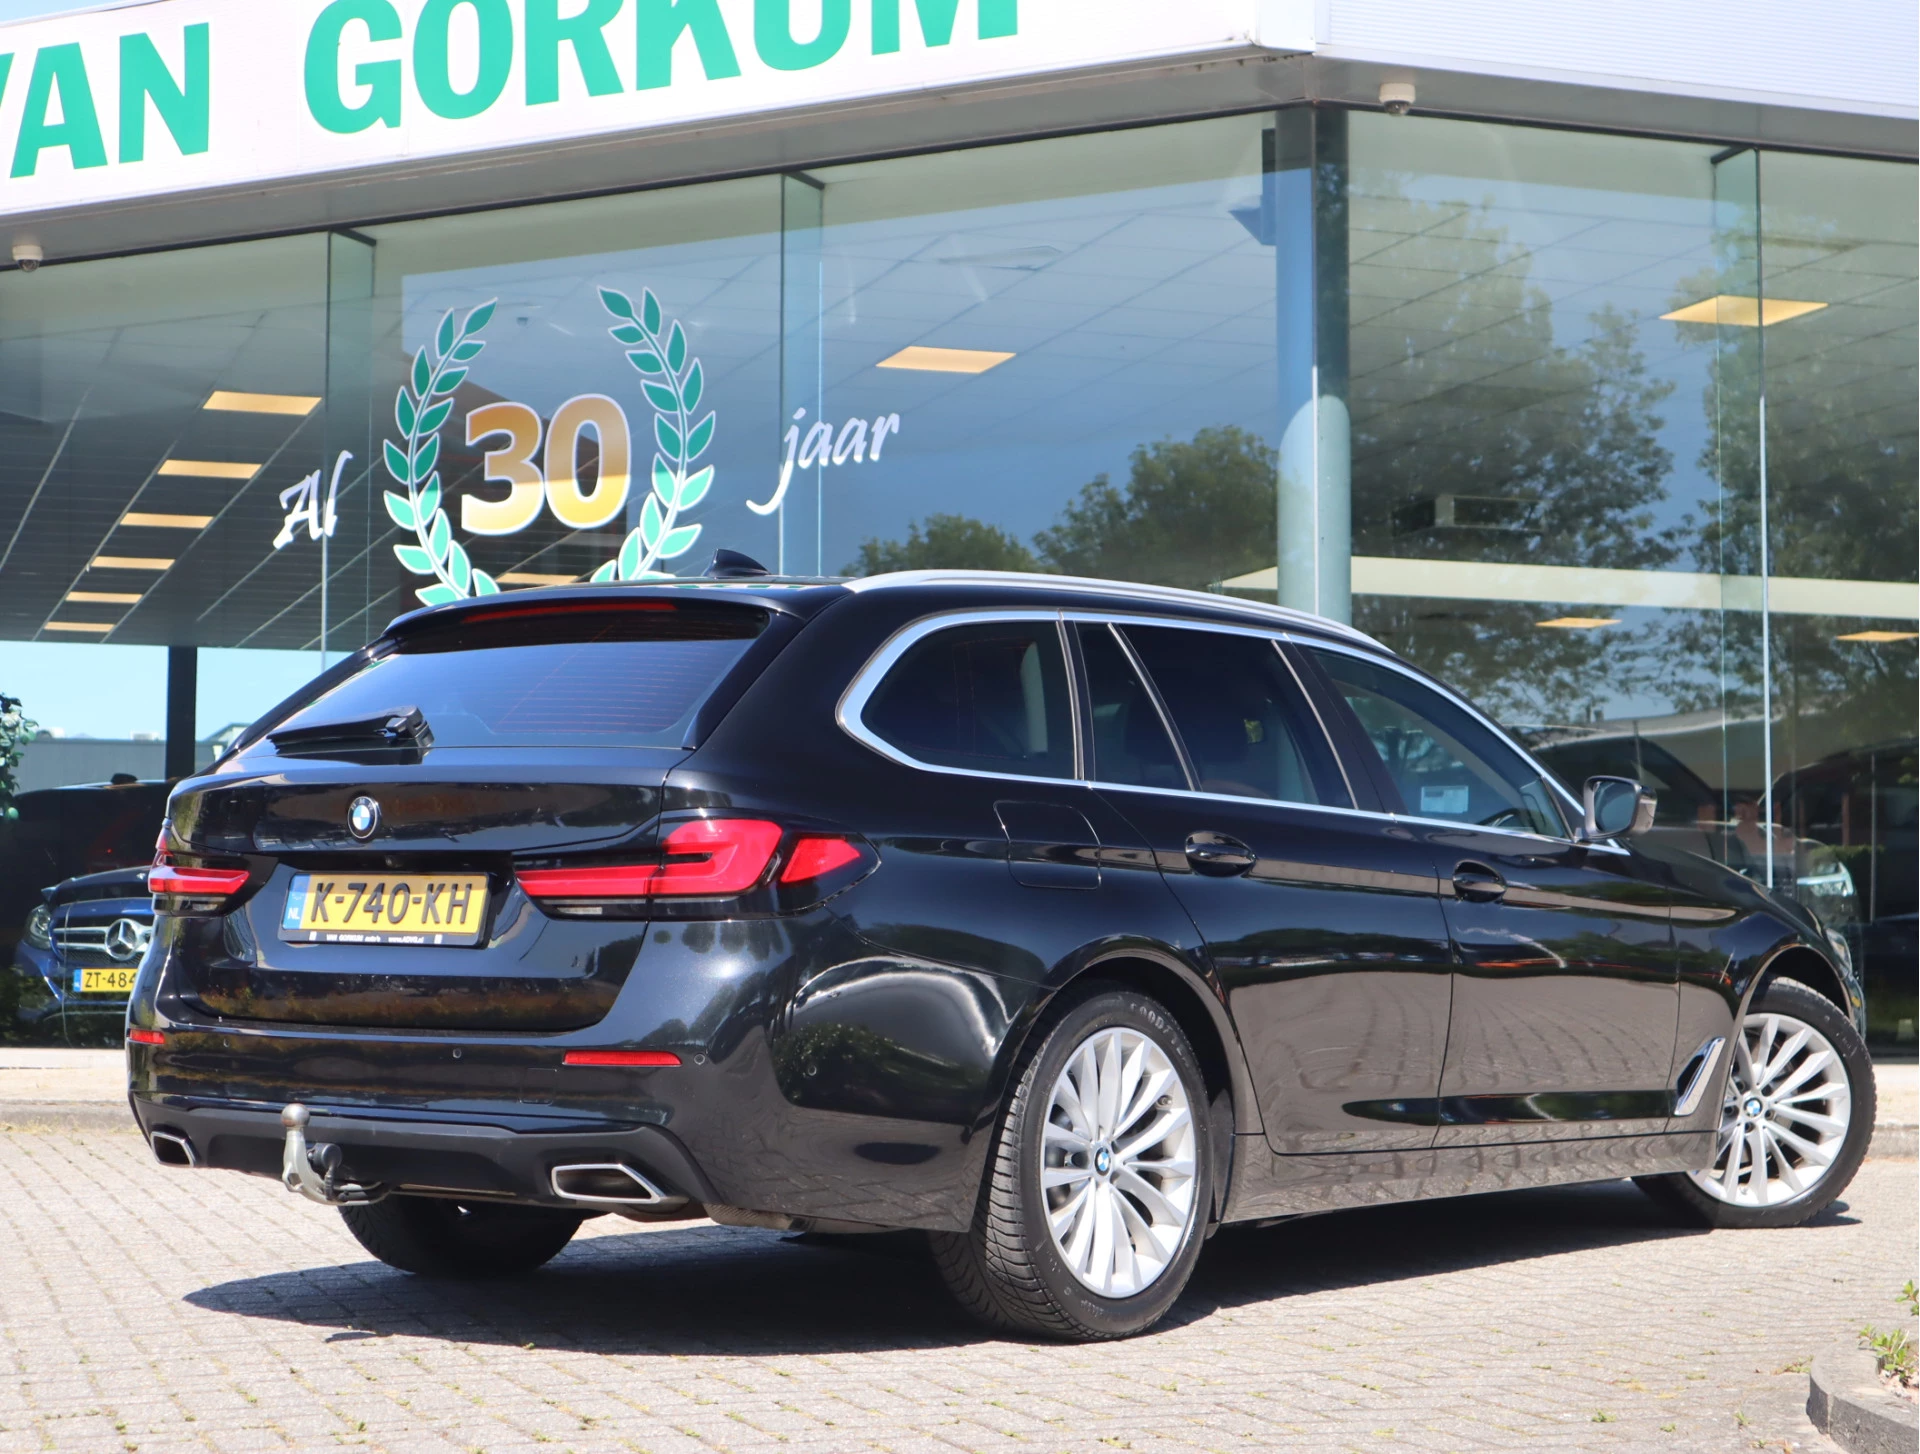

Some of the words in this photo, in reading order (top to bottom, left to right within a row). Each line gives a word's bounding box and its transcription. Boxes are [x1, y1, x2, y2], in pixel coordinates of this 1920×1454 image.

[0, 22, 210, 179] AN
[460, 393, 632, 536] 30
[745, 407, 900, 515] jaar
[287, 907, 301, 920] NL
[310, 882, 473, 925] K-740-KH
